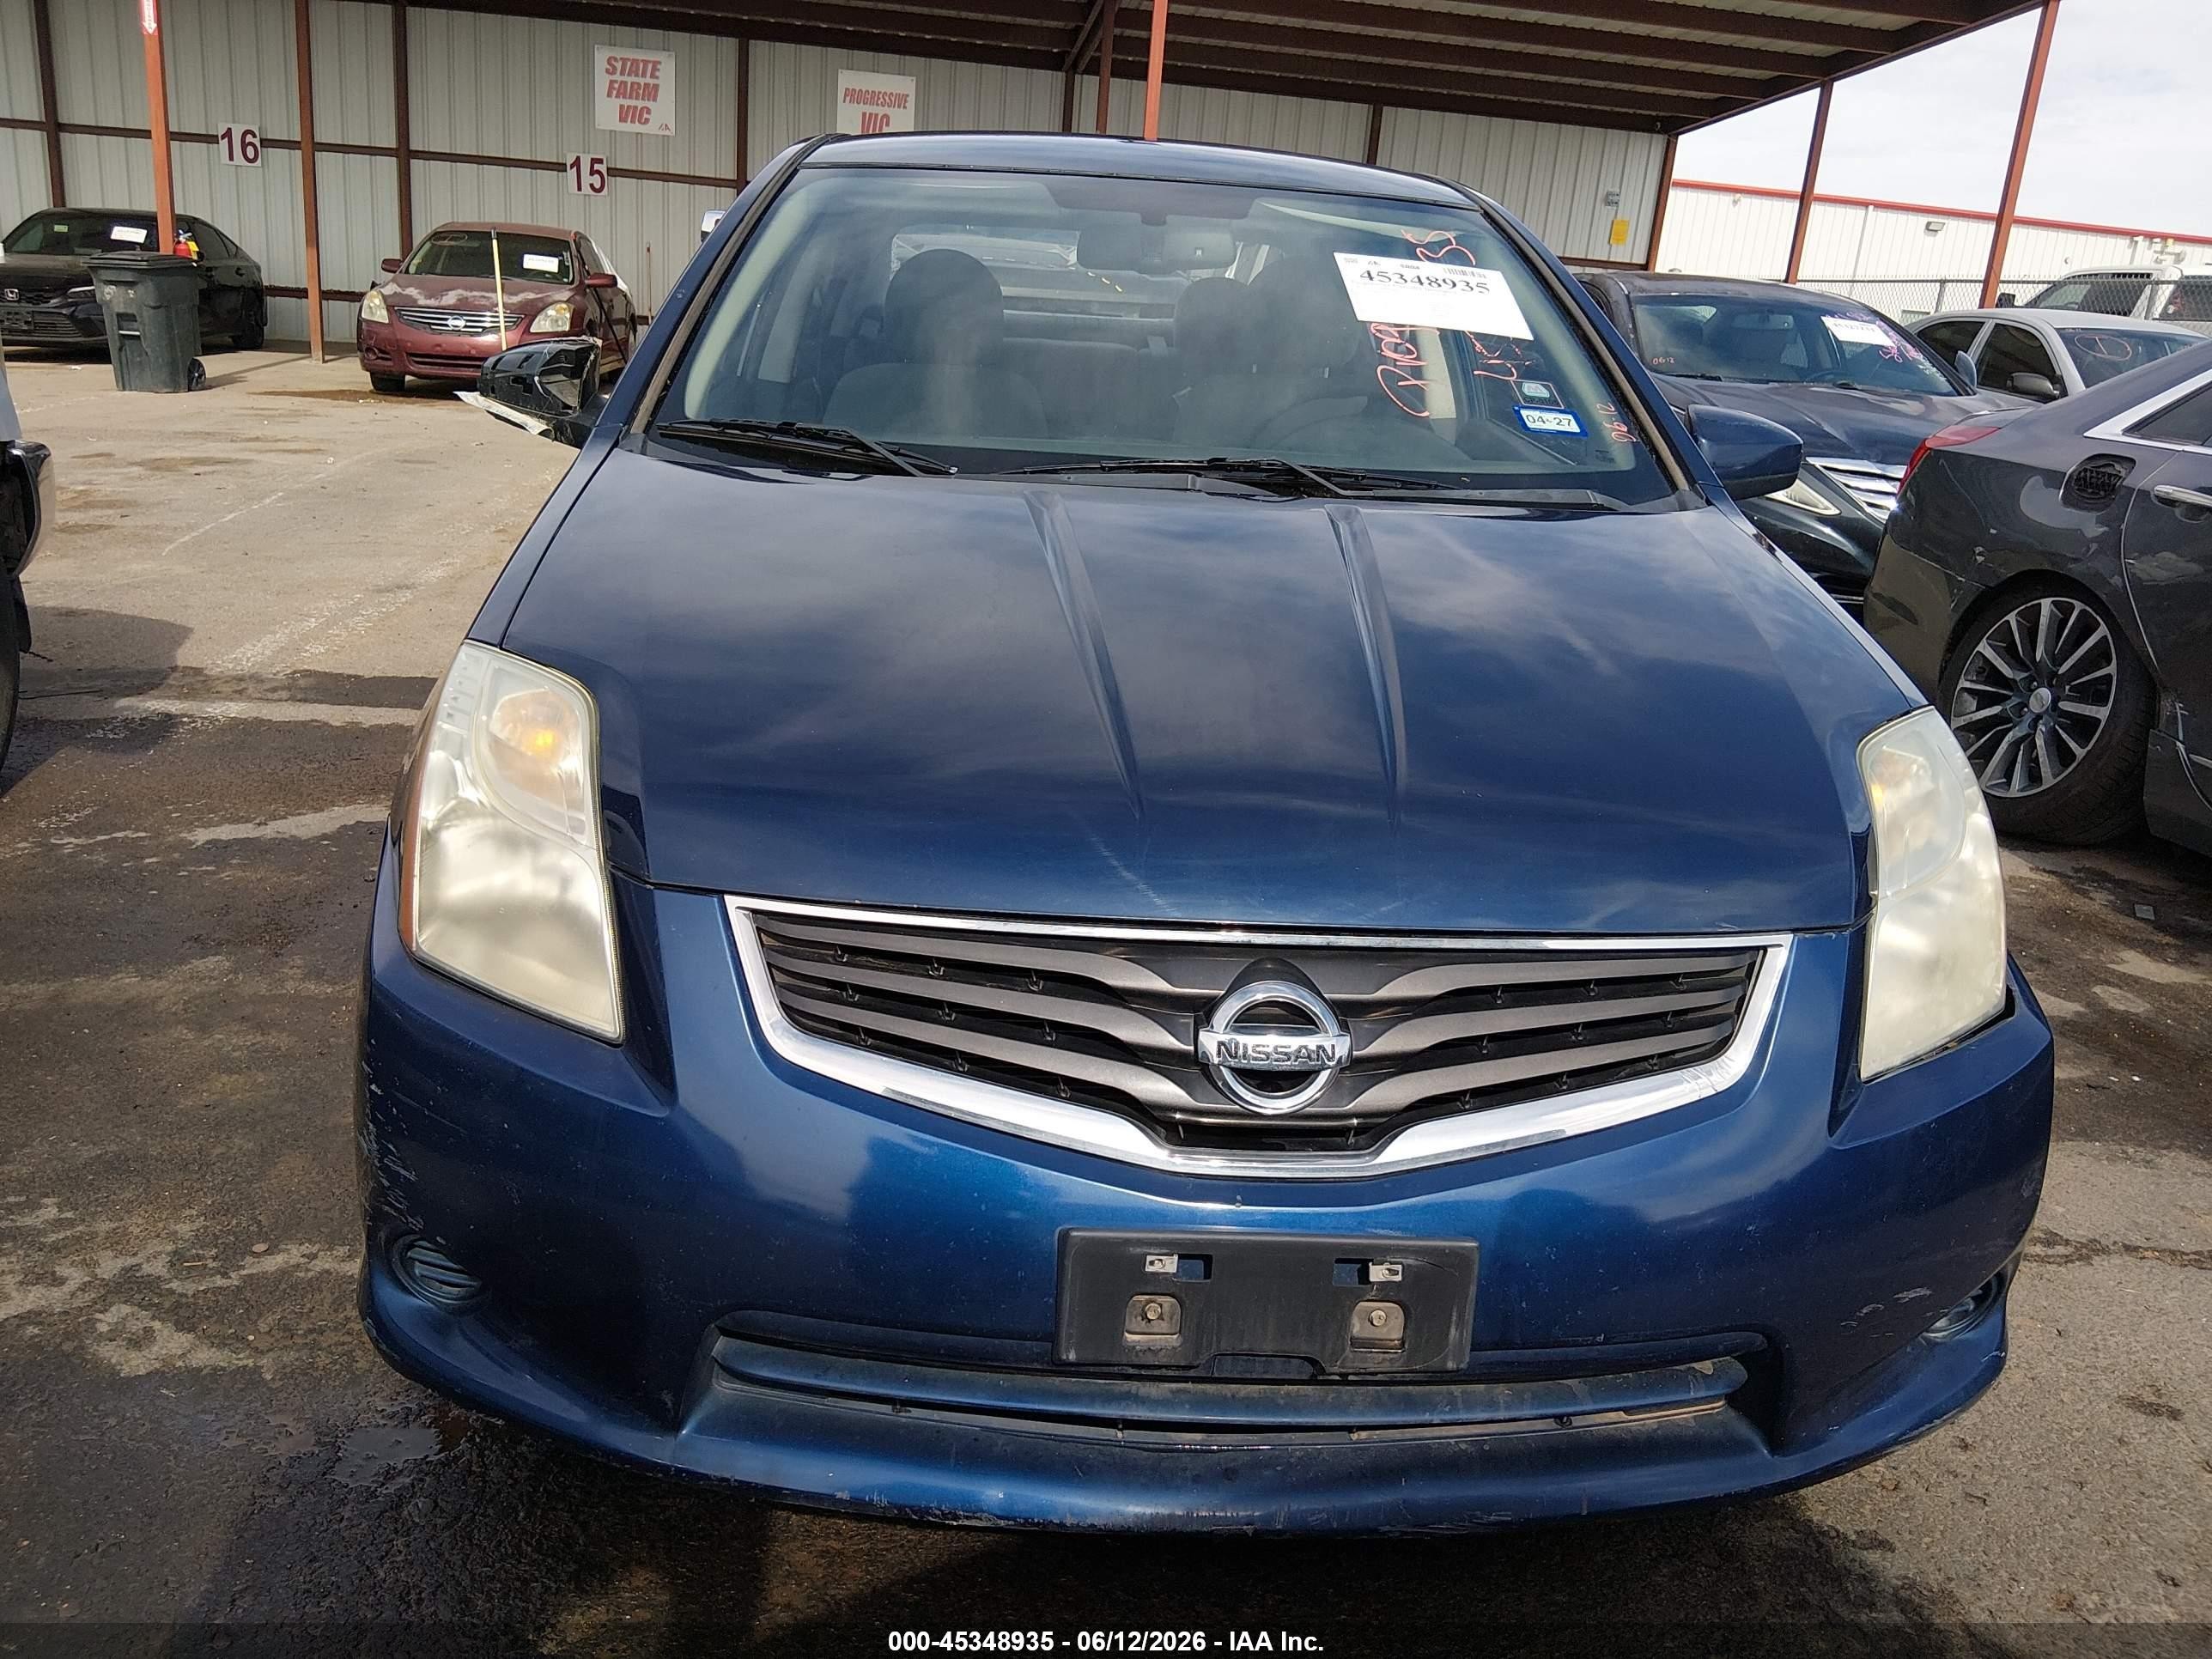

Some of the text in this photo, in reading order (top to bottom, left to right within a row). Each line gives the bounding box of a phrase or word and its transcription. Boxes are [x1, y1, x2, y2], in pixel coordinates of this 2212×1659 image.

[605, 55, 662, 80] STATE
[606, 79, 660, 103] FARM
[842, 87, 909, 110] PROGRESSIVE
[618, 104, 652, 125] VIC
[860, 111, 890, 136] VIC
[220, 127, 259, 164] 16
[569, 155, 606, 194] 15
[1359, 269, 1491, 295] 45348935
[1525, 414, 1573, 428] 04-27
[1216, 1038, 1337, 1064] NISSAN
